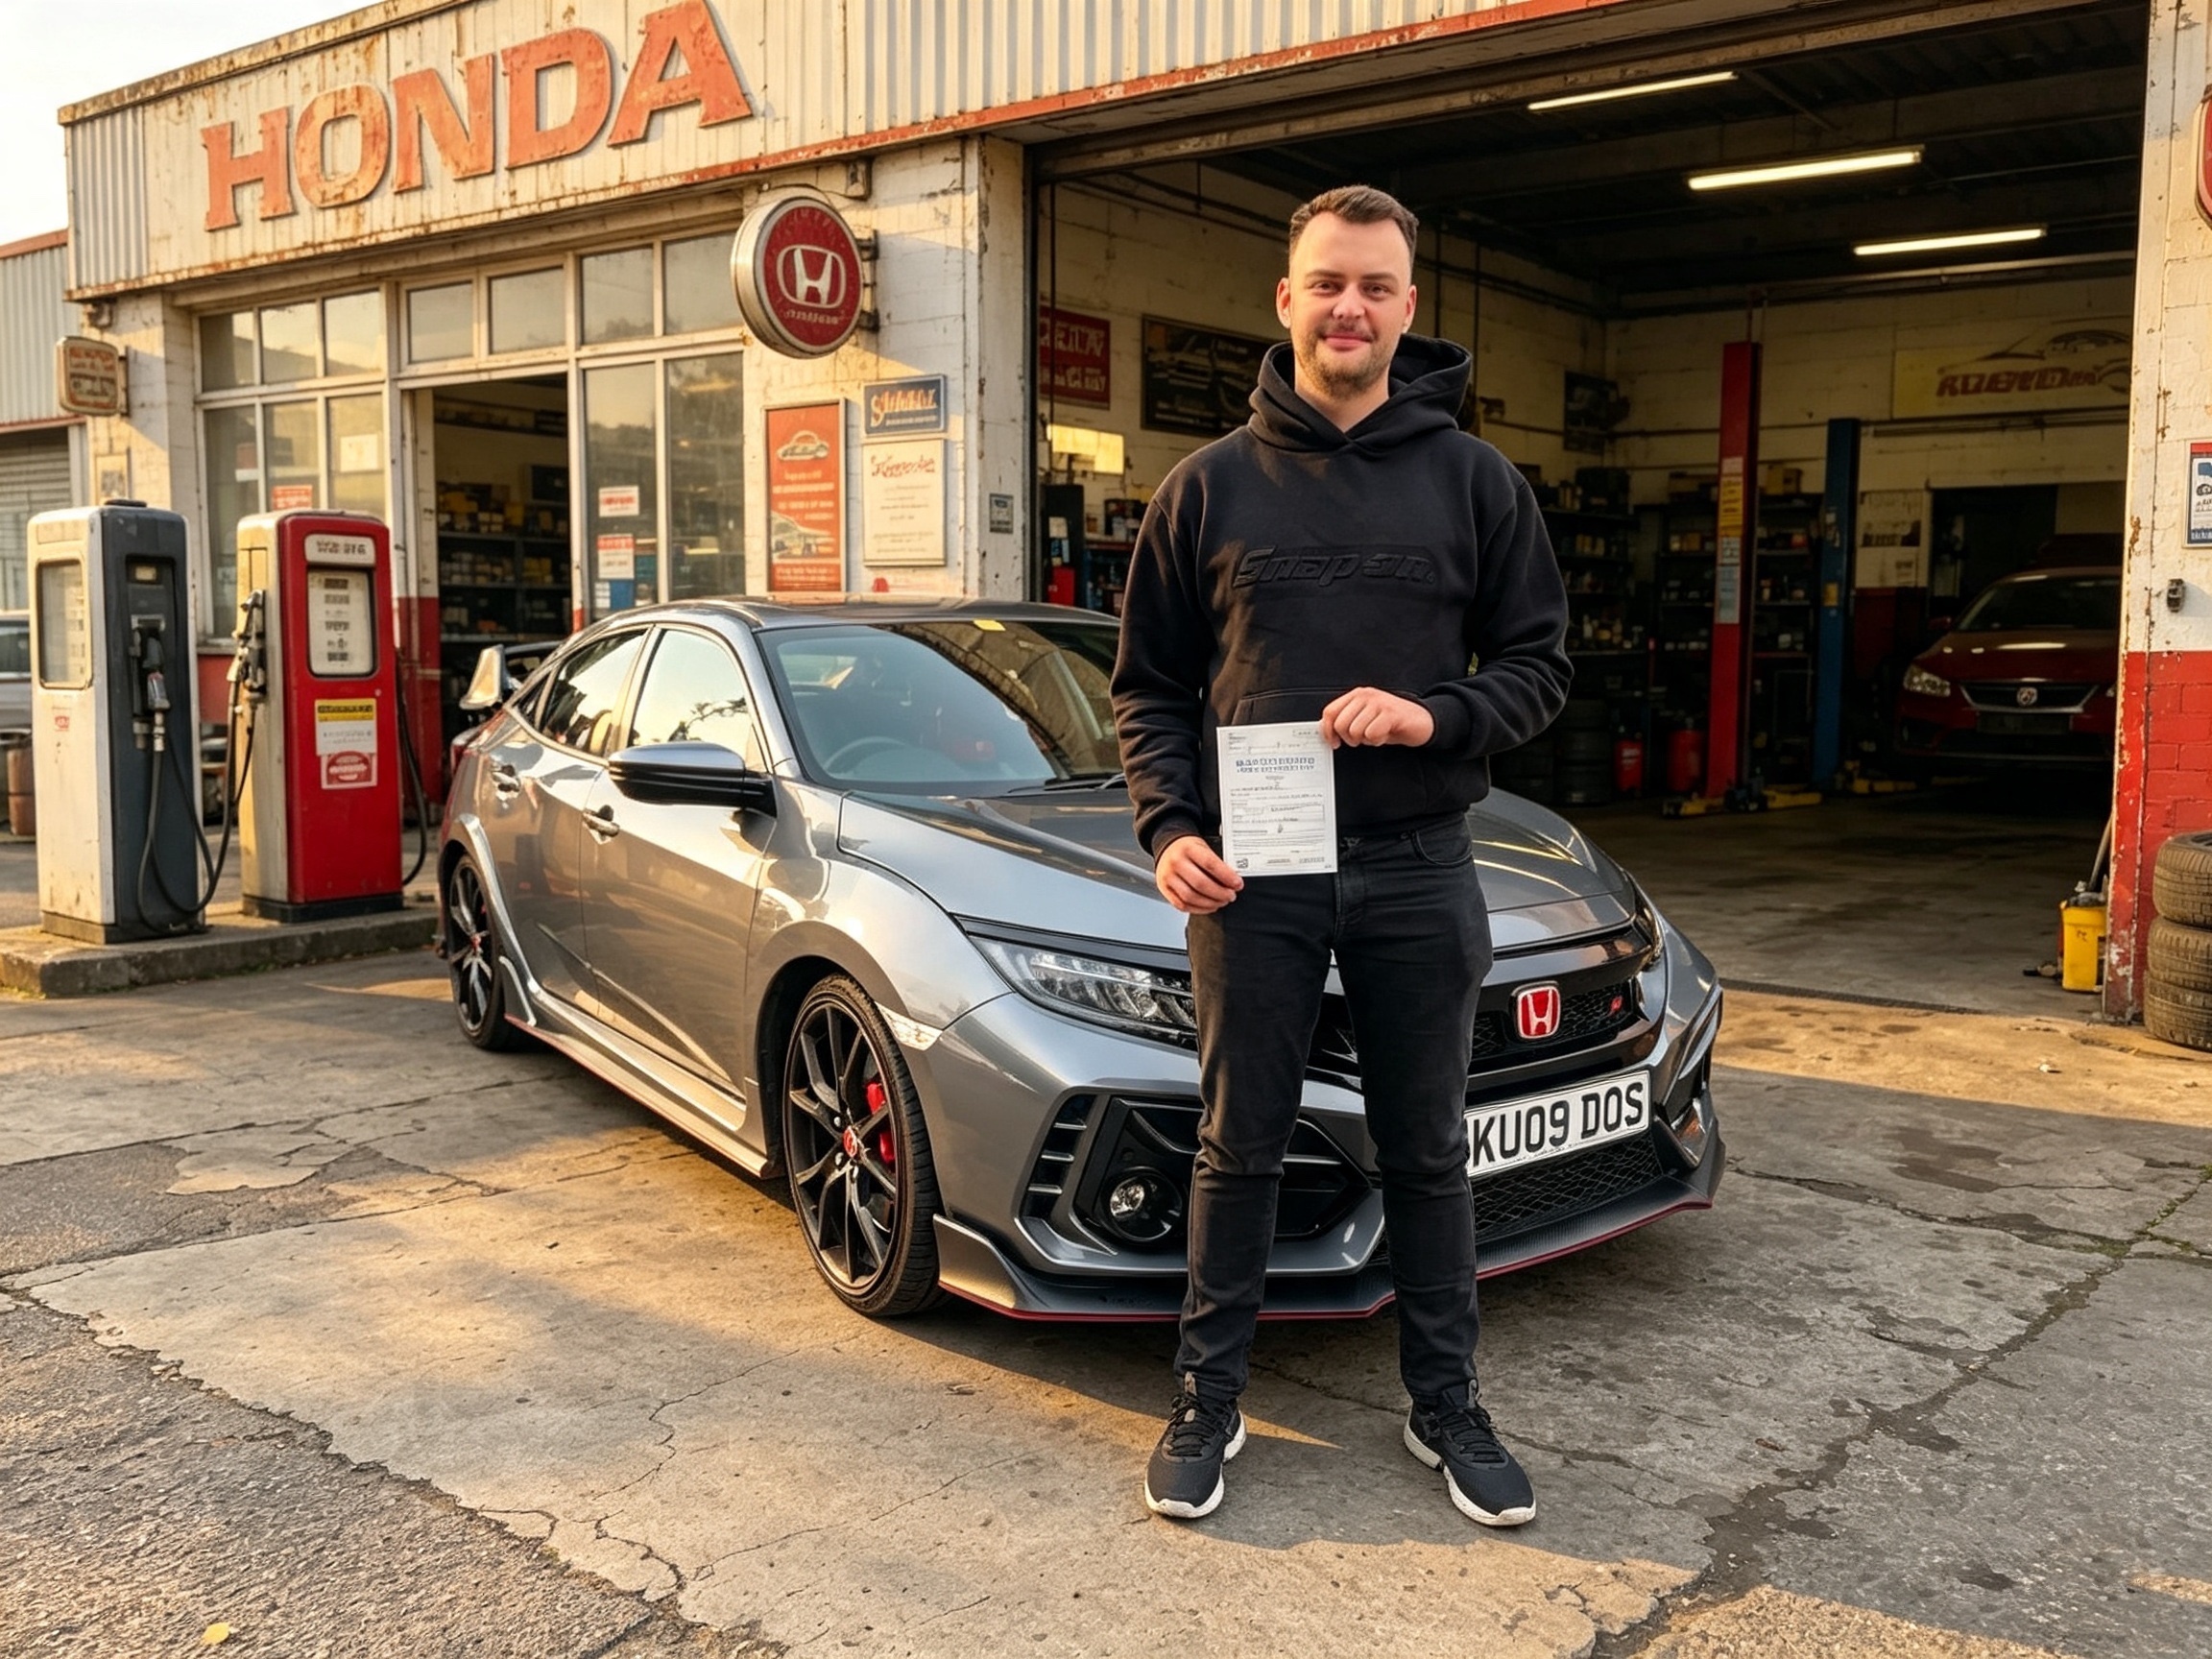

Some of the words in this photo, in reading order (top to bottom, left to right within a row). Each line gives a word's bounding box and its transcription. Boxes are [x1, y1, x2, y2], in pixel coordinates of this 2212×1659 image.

[201, 0, 752, 231] HONDA
[1473, 1099, 1570, 1167] KU09
[1580, 1081, 1644, 1141] DOS
